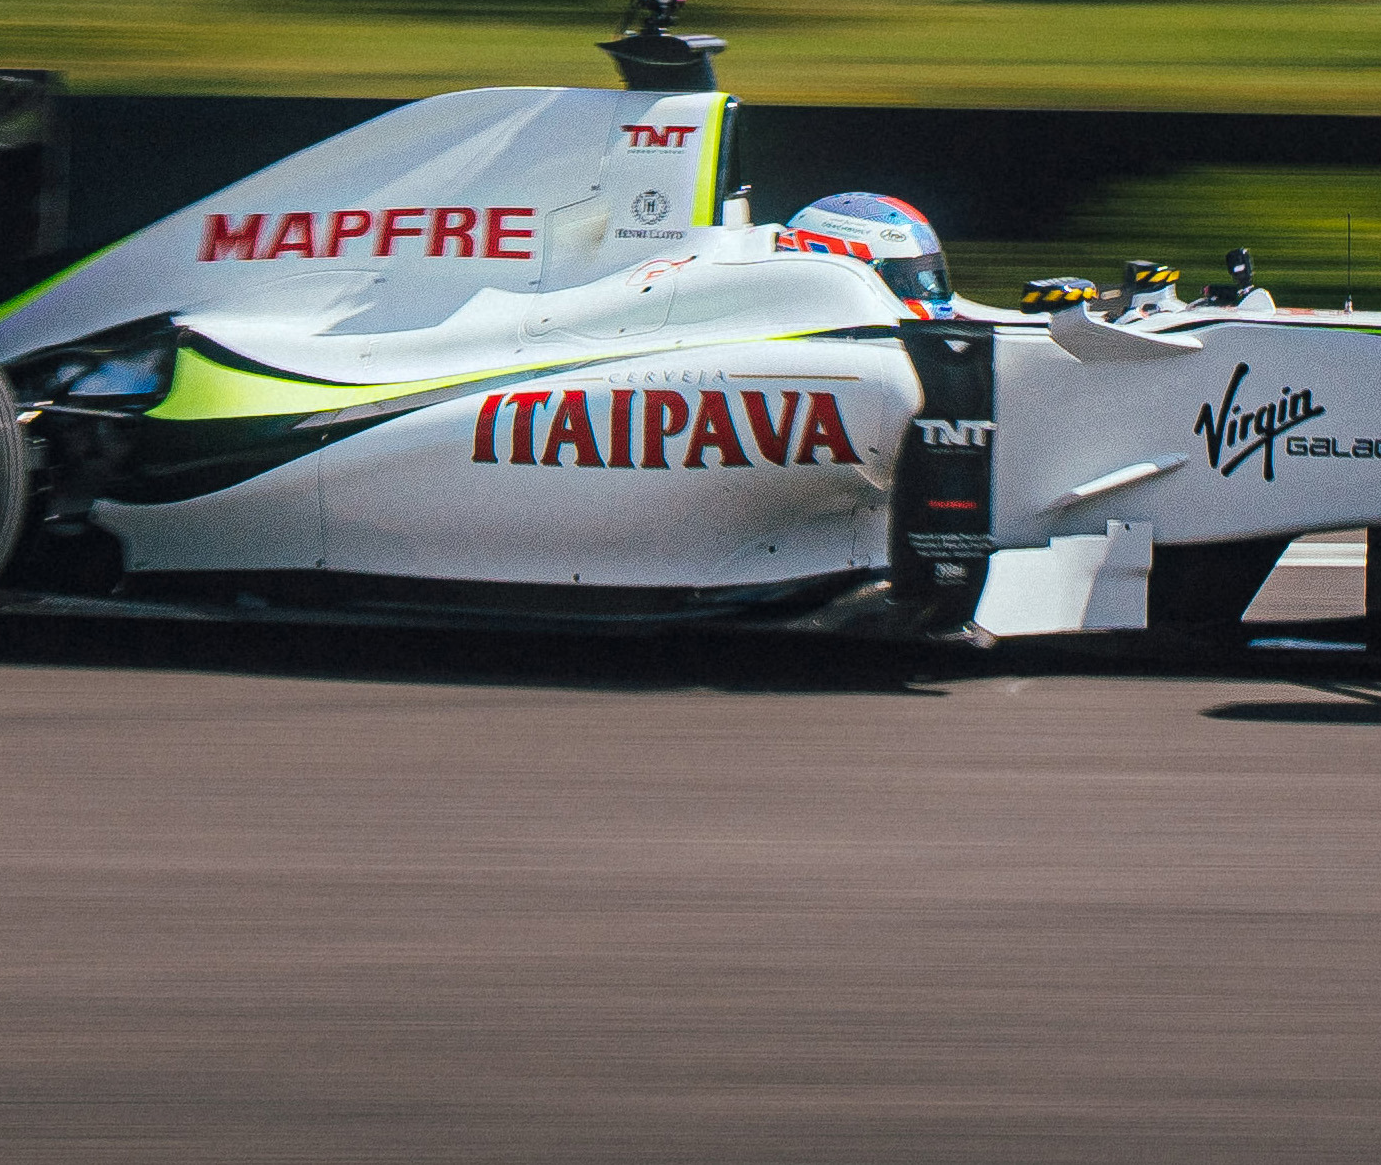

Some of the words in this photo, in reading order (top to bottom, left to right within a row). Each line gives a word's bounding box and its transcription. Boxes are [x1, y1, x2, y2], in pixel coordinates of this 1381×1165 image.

[621, 124, 698, 147] TNT
[197, 208, 534, 262] MAPFRE
[609, 370, 728, 384] CERVEJA
[472, 389, 864, 468] ITAIPAVA
[915, 419, 998, 446] TNT
[1194, 362, 1325, 481] Virgin
